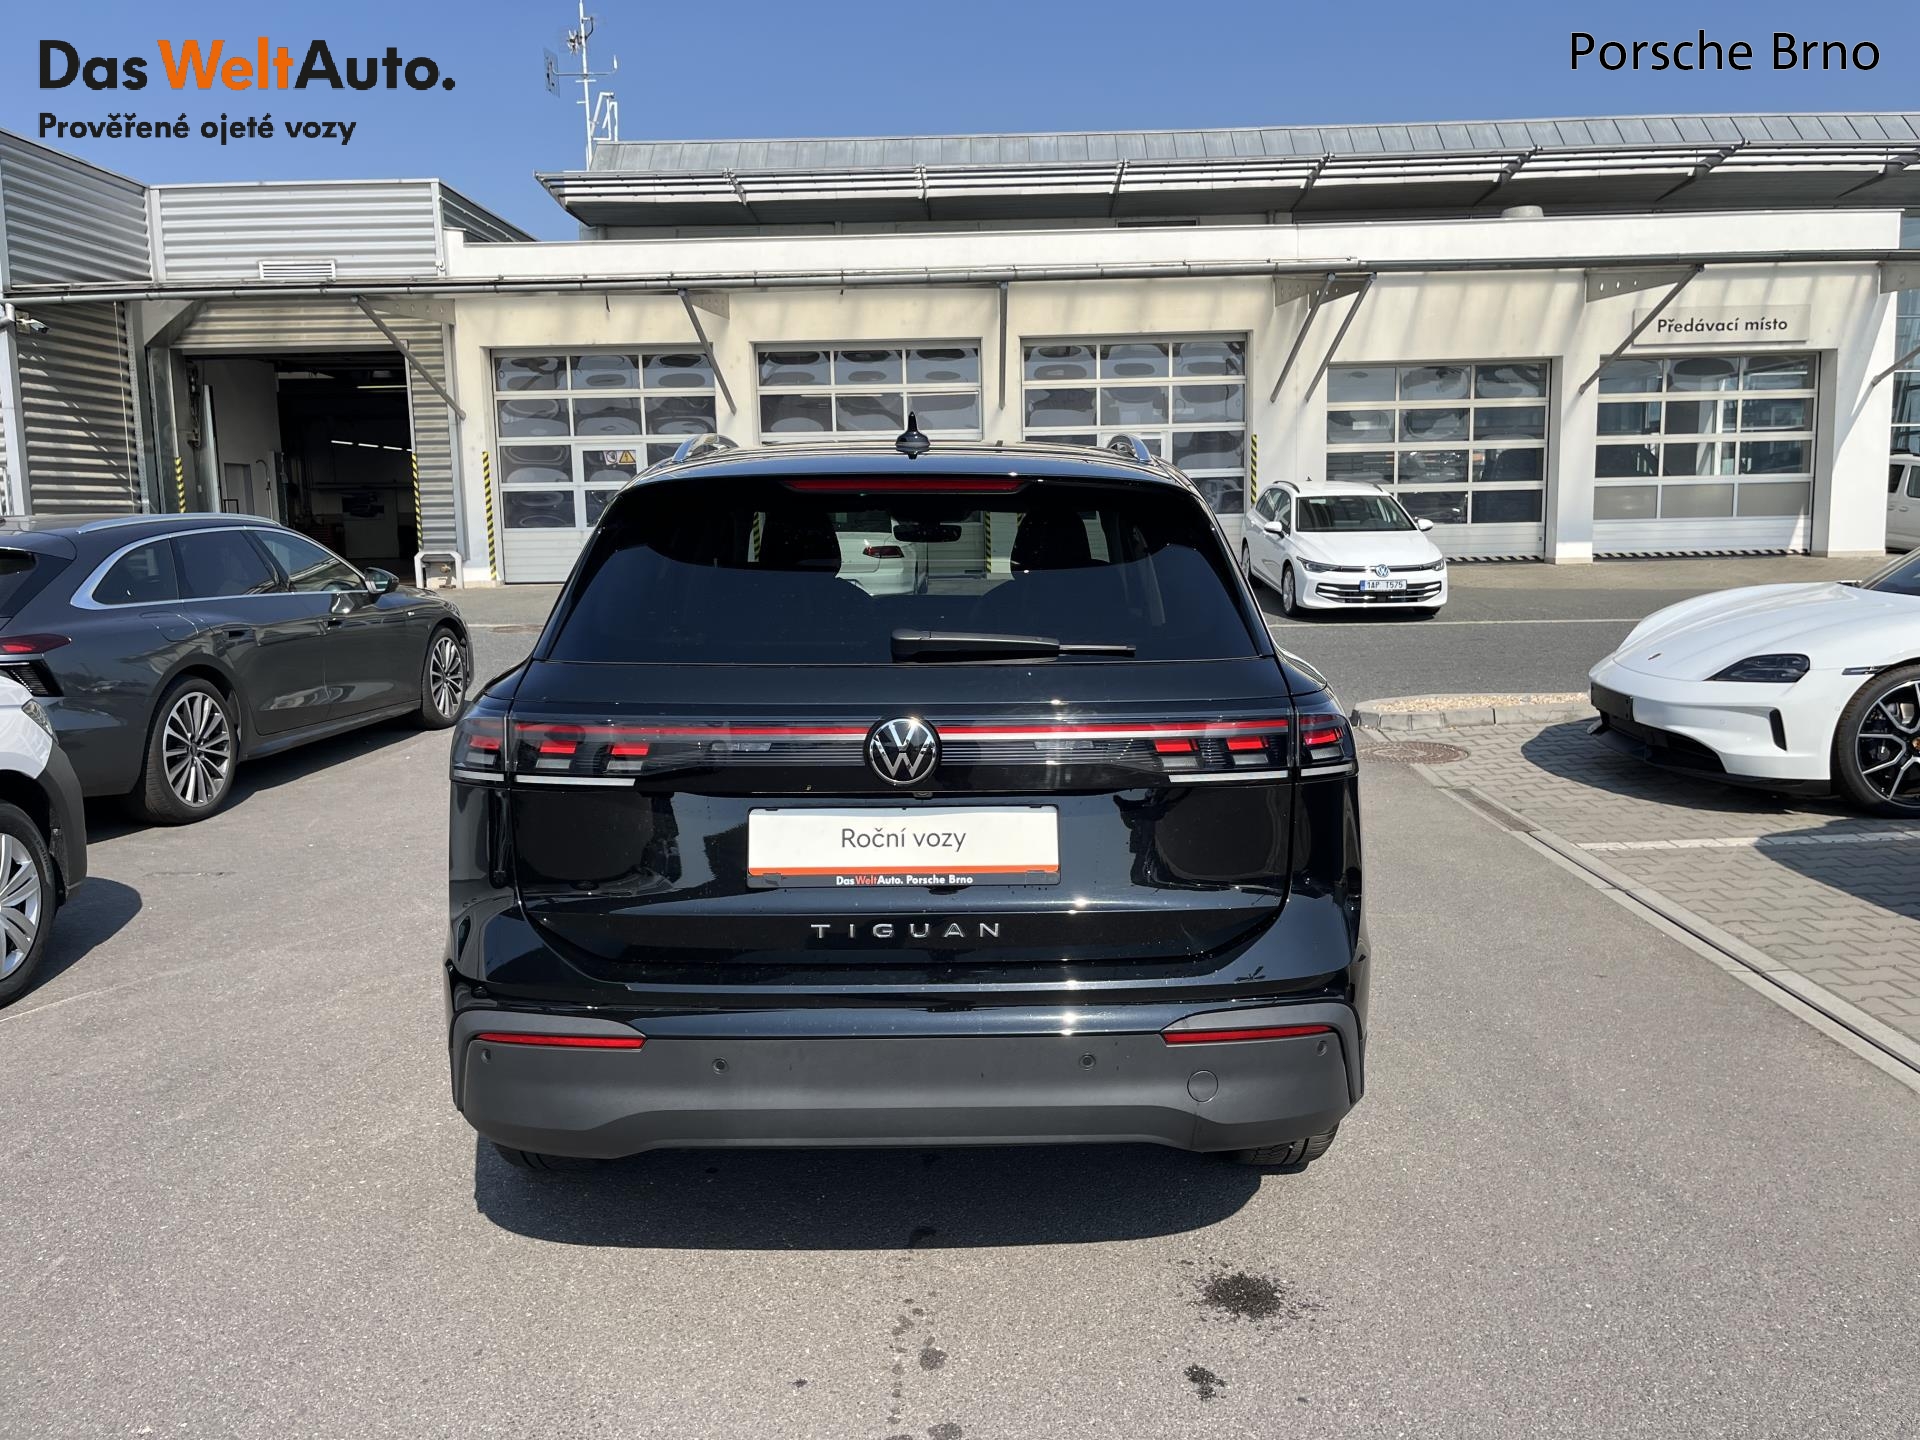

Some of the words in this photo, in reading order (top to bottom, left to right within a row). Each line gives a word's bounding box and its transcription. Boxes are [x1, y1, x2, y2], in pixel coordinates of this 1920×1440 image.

[1657, 317, 1740, 333] Předávací
[1744, 316, 1788, 331] místo
[841, 827, 907, 849] Roční
[913, 832, 967, 852] vozy
[906, 874, 946, 884] Porsche
[948, 874, 974, 884] Brno
[810, 922, 1000, 939] TIGUAN
